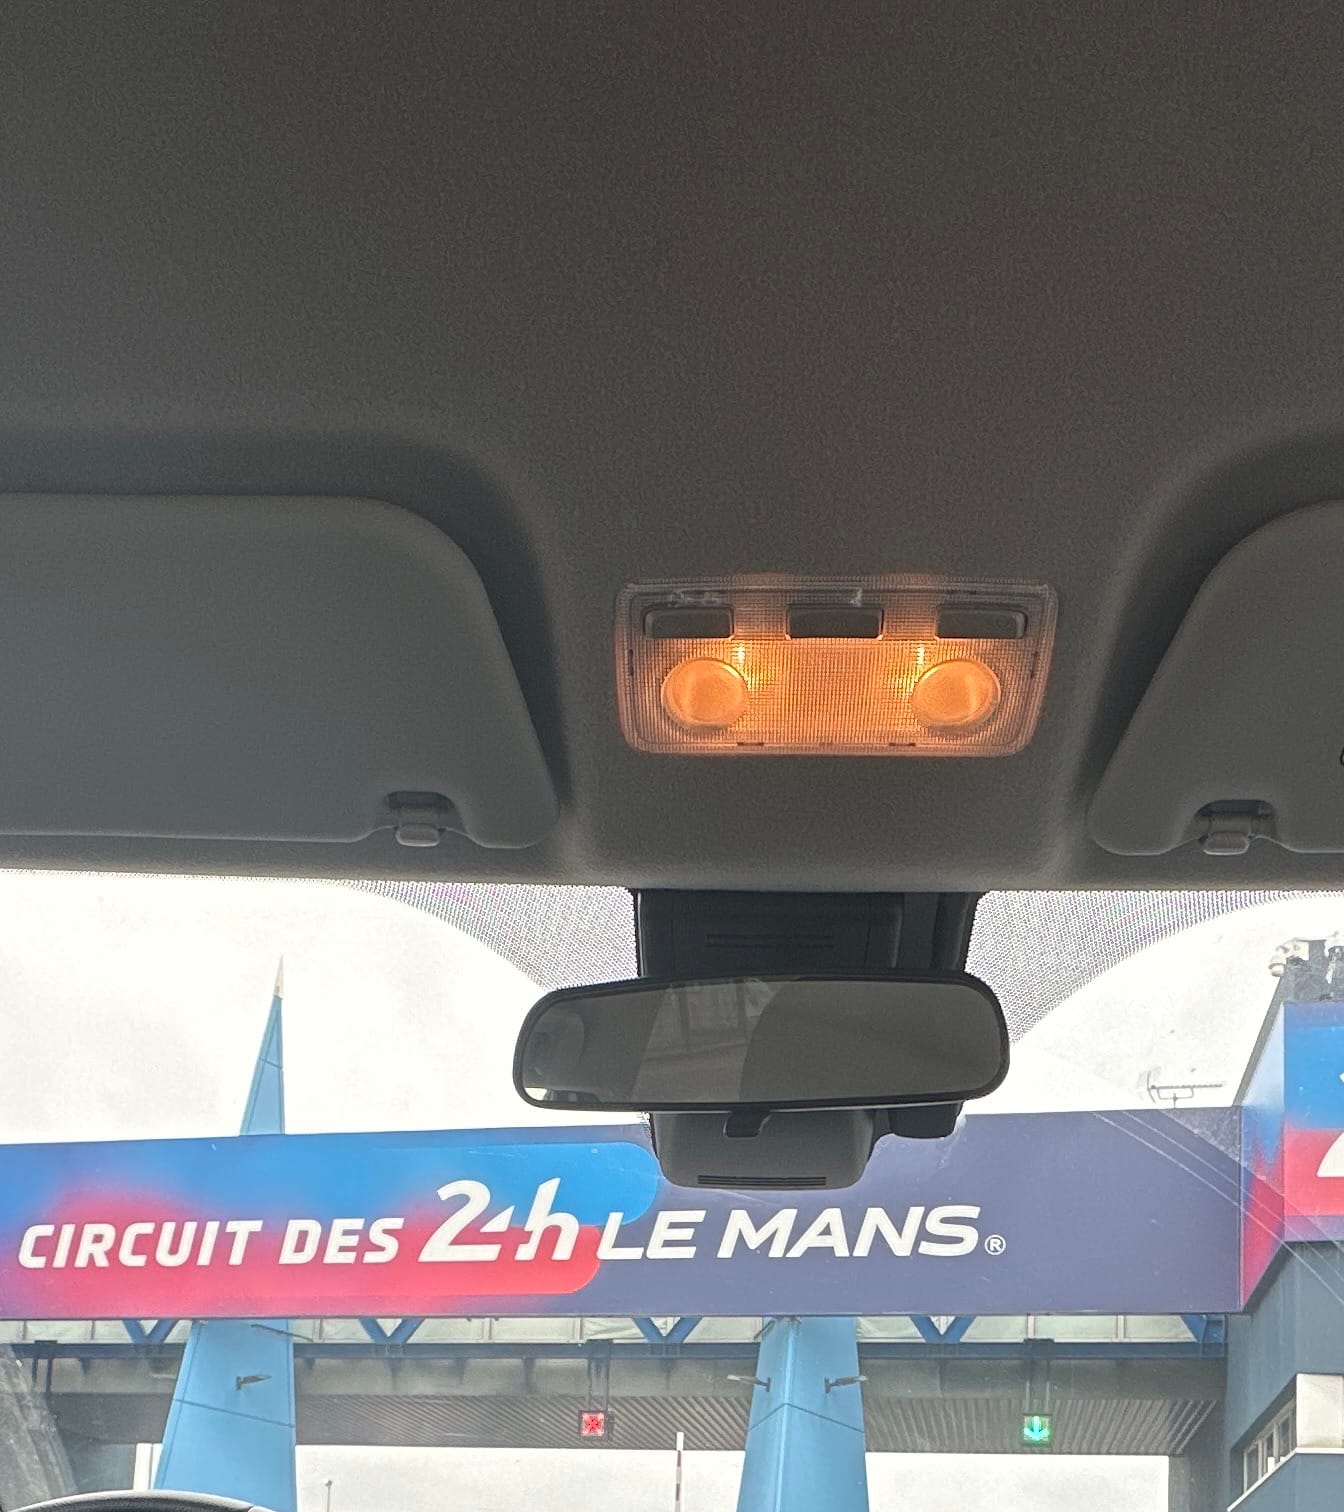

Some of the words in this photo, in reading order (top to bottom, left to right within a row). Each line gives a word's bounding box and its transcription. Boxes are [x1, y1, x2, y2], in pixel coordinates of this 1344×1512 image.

[18, 1219, 263, 1268] CIRCUIT
[278, 1217, 404, 1264] DES
[596, 1209, 707, 1260] LE
